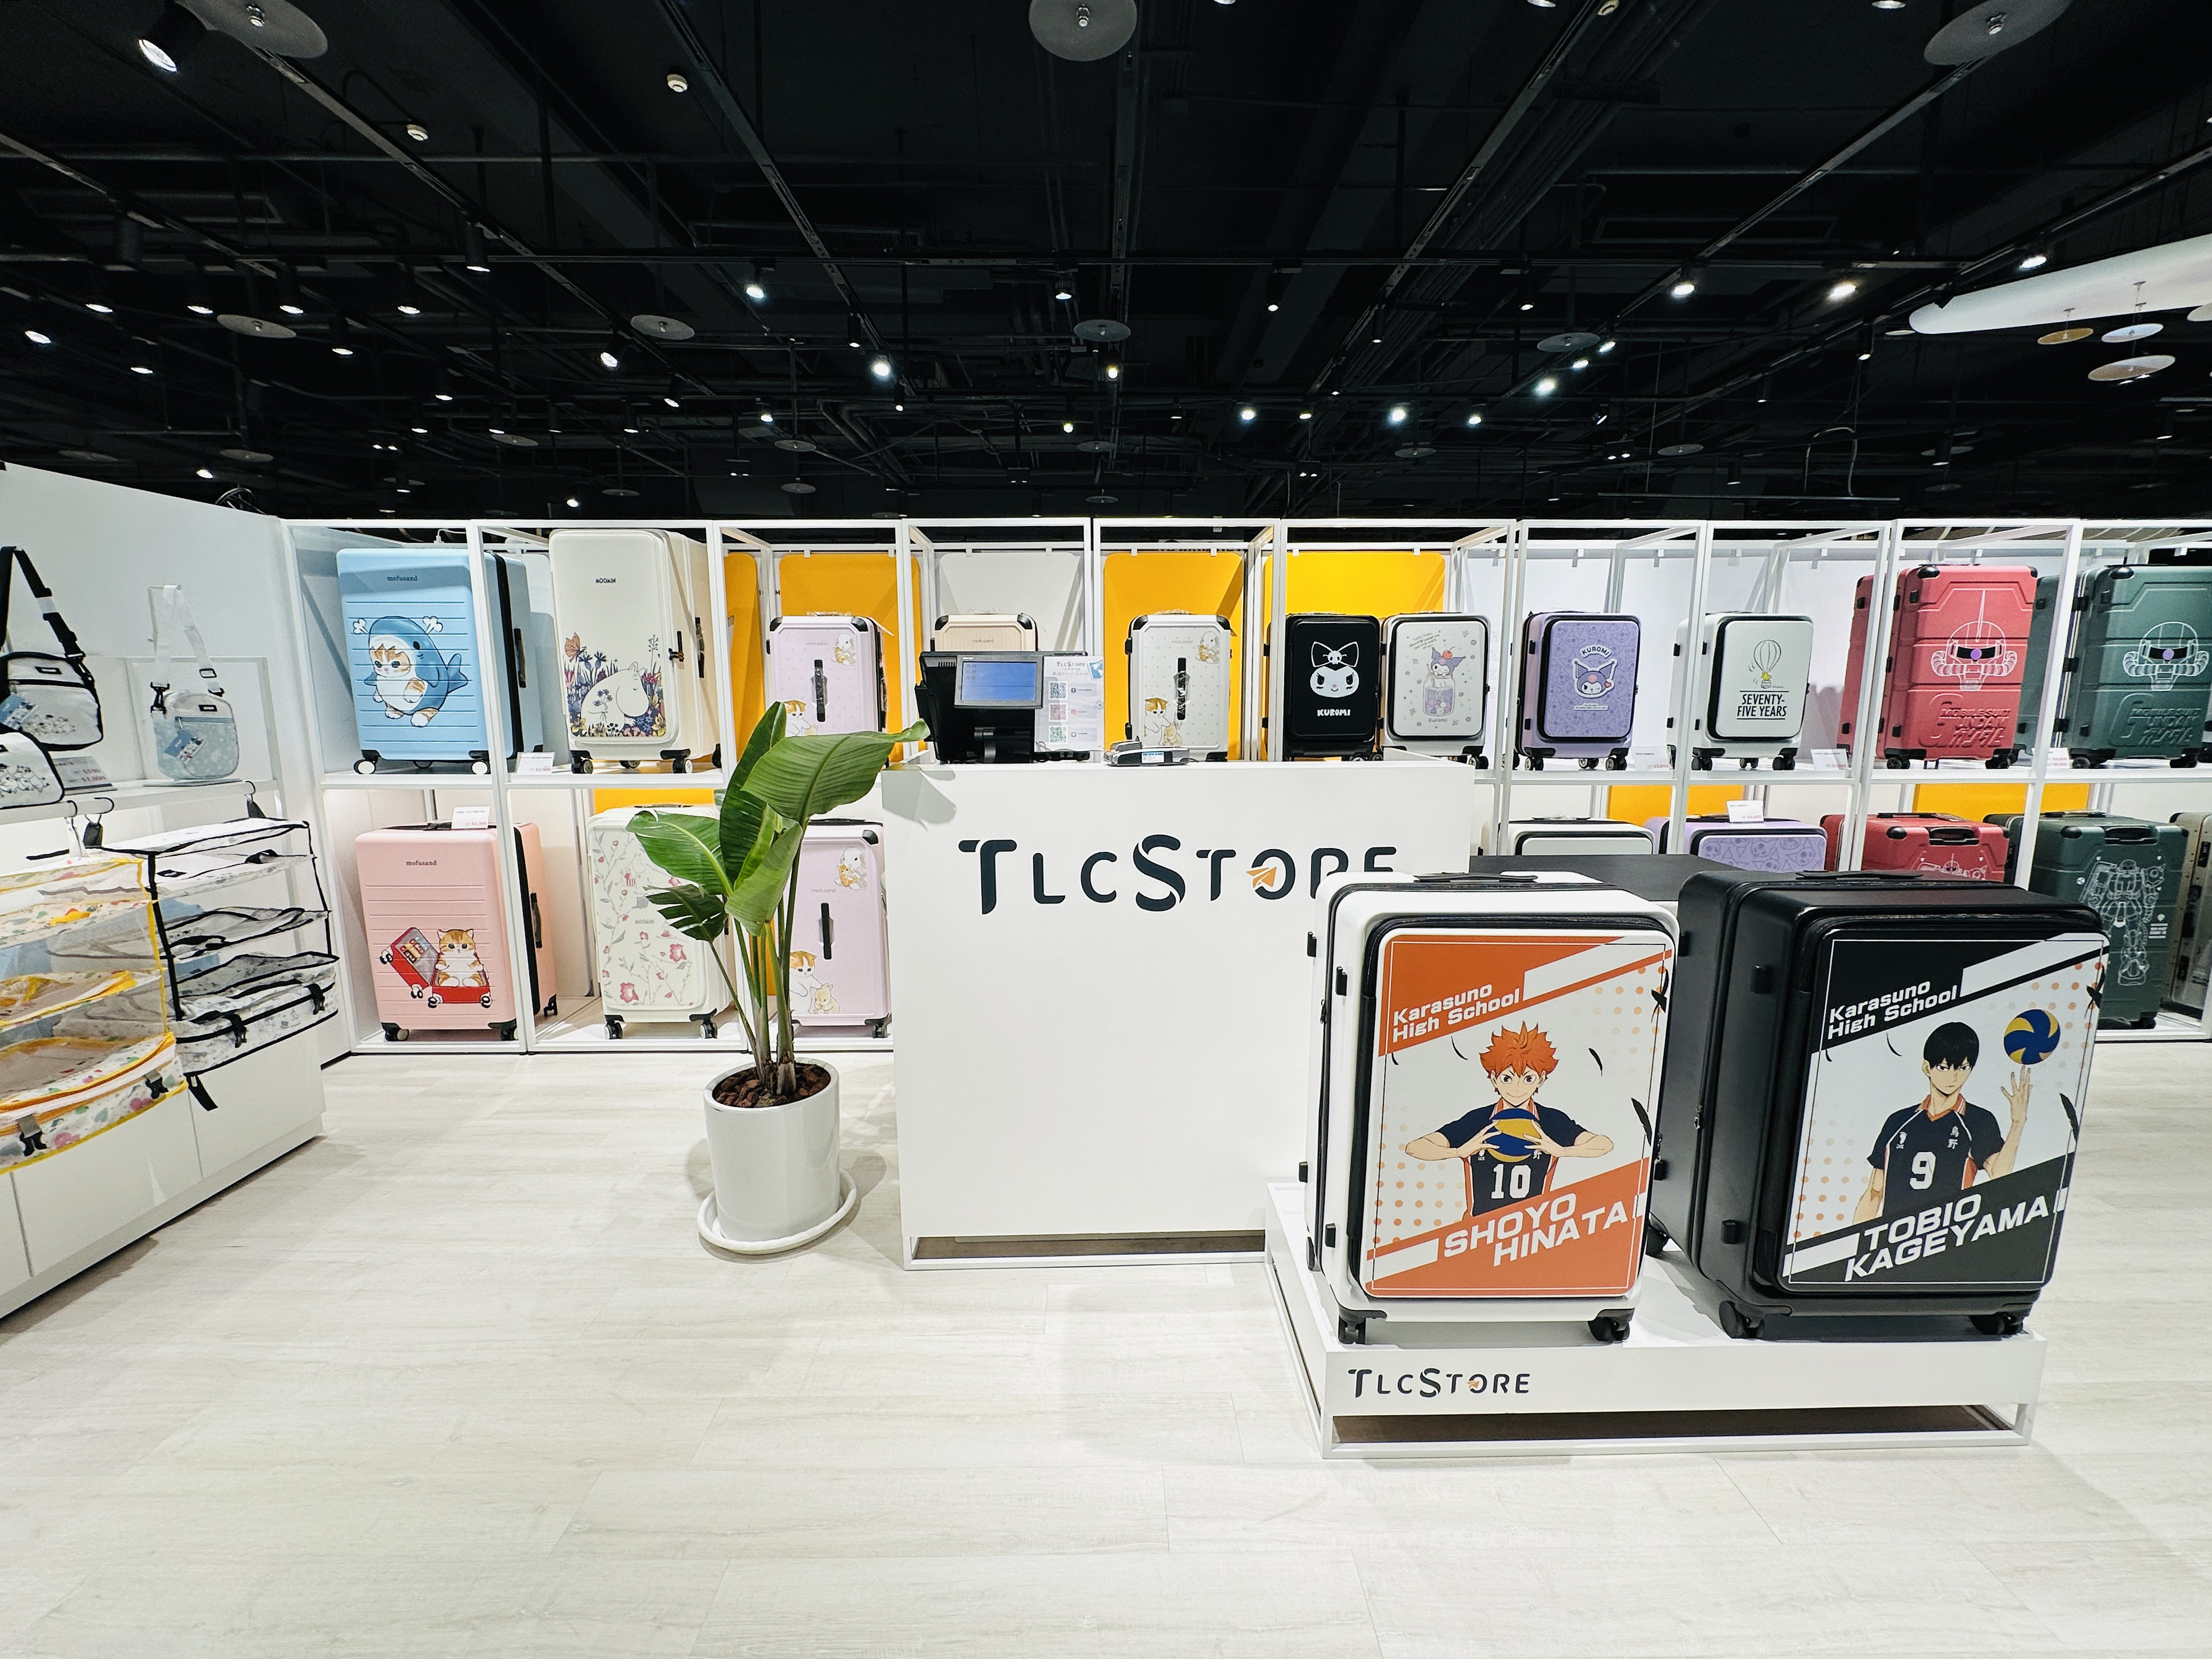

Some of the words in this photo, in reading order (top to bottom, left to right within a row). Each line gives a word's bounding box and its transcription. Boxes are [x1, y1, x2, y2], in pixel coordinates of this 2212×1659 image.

[1581, 645, 1611, 658] KUROMI
[1317, 708, 1351, 717] KUROMI
[1737, 705, 1757, 717] FIVE
[1759, 705, 1787, 717] YEARS
[1742, 693, 1785, 705] SEVENTY-
[1392, 1017, 1440, 1043] High
[1448, 988, 1519, 1026] School
[1393, 983, 1492, 1026] Karasuno
[1828, 1015, 1877, 1039] High
[1884, 985, 1958, 1023] School
[1829, 980, 1931, 1024] Karasuno
[1490, 1165, 1531, 1200] 10
[1909, 1152, 1937, 1190] 9
[1444, 1193, 1577, 1258] SHOYO
[1492, 1203, 1628, 1267] HINATA
[1845, 1194, 2049, 1281] KAGEYAMA
[1863, 1193, 1982, 1249] TOBIO
